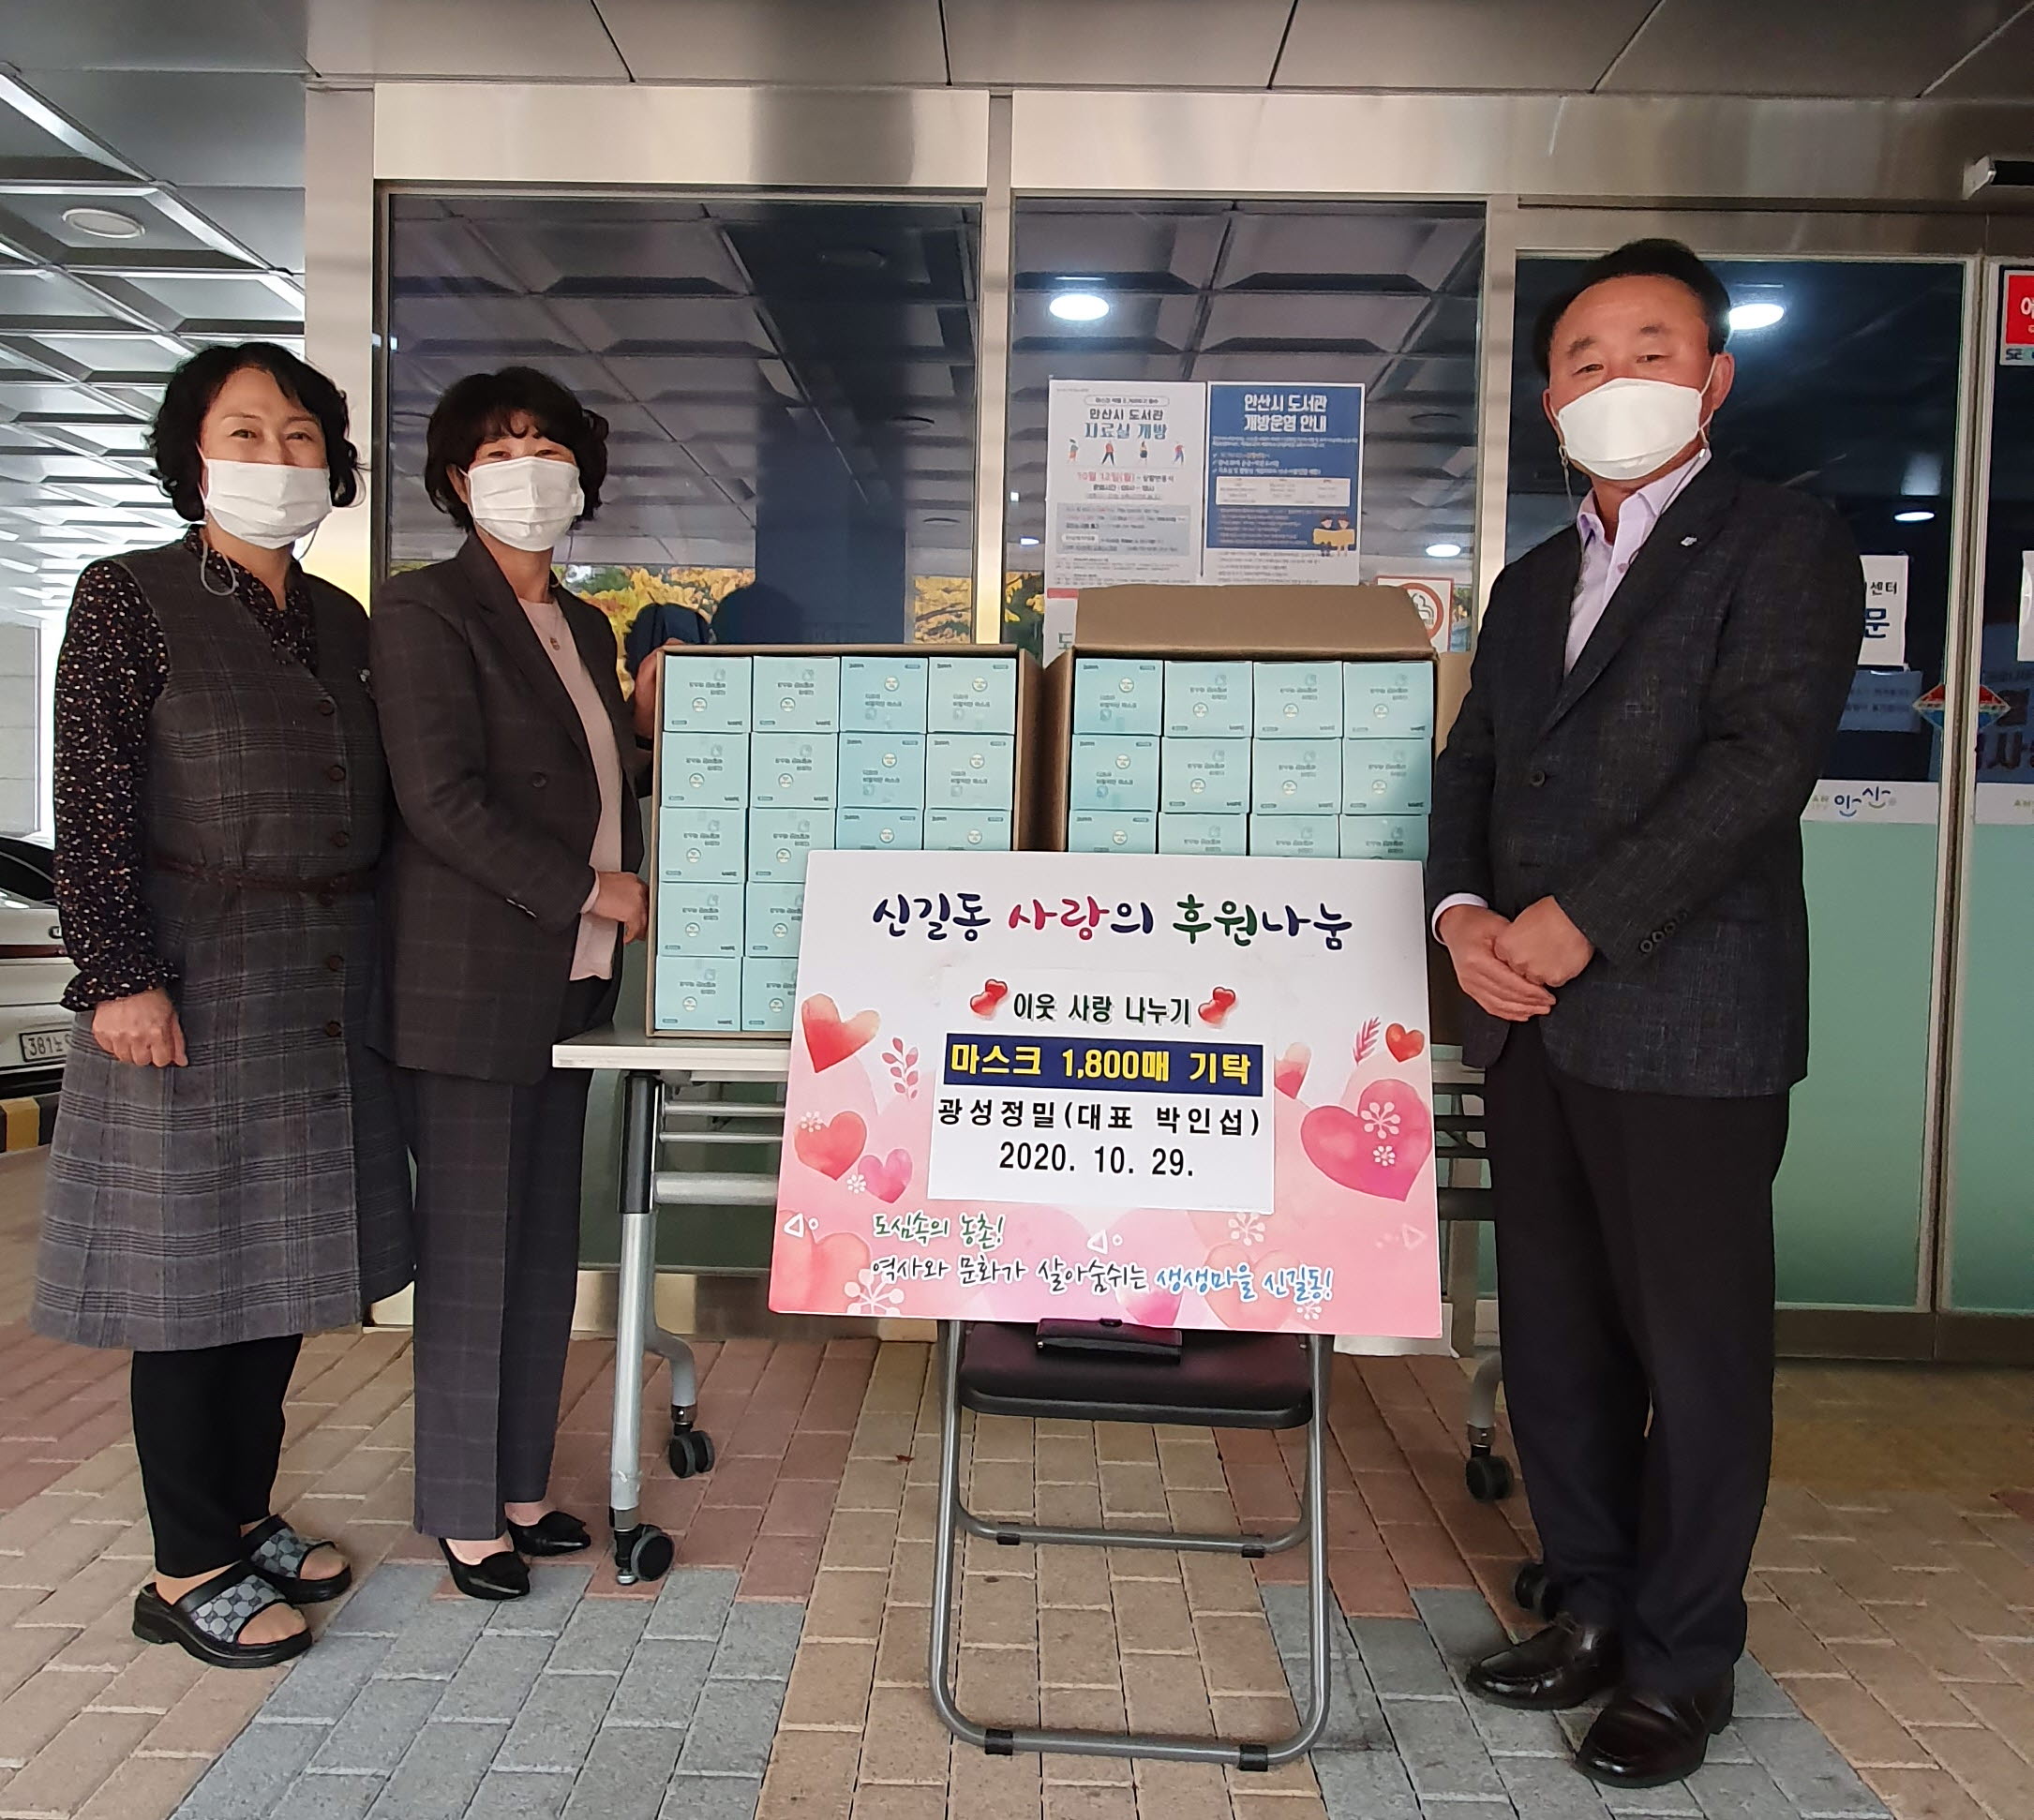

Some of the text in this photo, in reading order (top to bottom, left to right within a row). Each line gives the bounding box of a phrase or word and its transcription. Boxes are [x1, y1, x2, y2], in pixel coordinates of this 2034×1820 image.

[1089, 408, 1163, 421] 안산시 도서관
[1244, 394, 1327, 412] 안산시 도서관
[1084, 422, 1167, 440] 자료실 개방
[1244, 414, 1326, 432] 개방운영 안내
[1864, 581, 1897, 595] 센터
[873, 893, 1352, 950] 신길동 사랑의 후원나눔
[1013, 992, 1190, 1025] 이웃 사랑 나누기
[950, 1044, 1251, 1085] 마스크 1,800매 기탁
[938, 1098, 1259, 1136] 광성정밀(대표 박인섭)
[999, 1141, 1193, 1176] 2020. 10. 29.
[874, 1214, 1005, 1248] 도심속의 농촌!
[873, 1256, 1333, 1302] 역사와 문화가 살아숨쉬는 생생마을 신길동!
